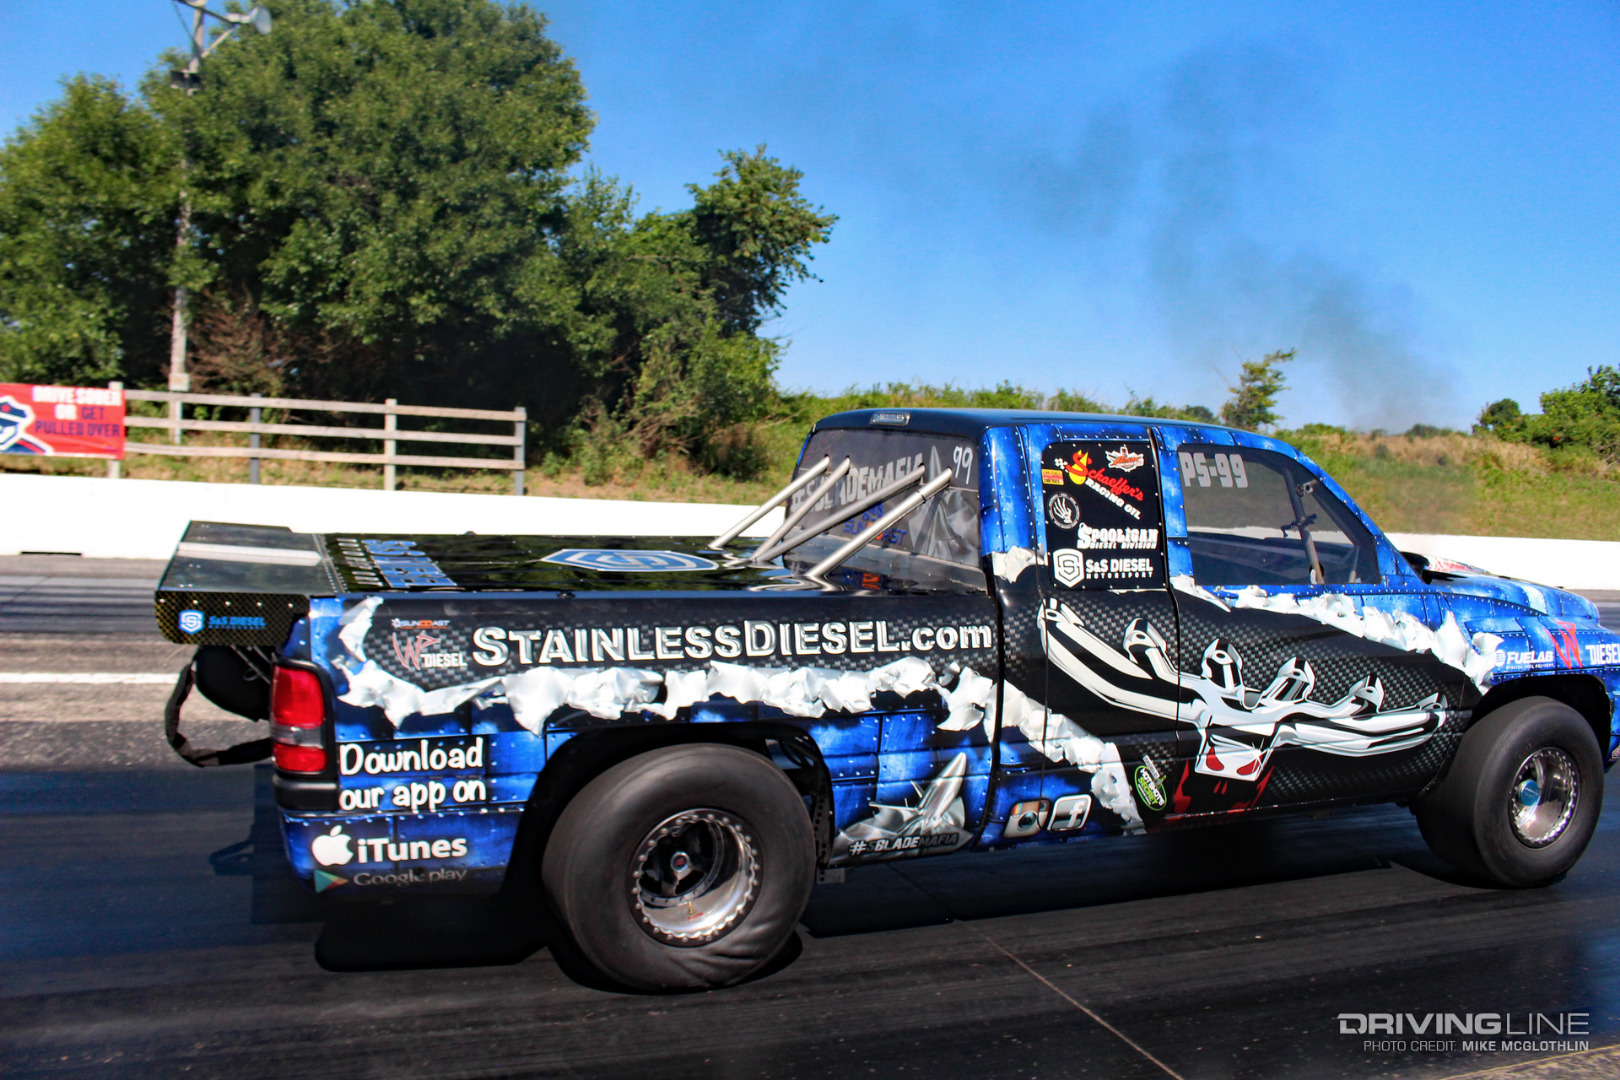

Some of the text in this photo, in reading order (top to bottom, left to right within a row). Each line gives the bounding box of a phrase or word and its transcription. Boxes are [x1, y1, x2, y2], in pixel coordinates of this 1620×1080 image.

[81, 406, 104, 420] GET
[35, 421, 119, 437] PULLED OVER
[952, 446, 973, 484] 99
[1179, 452, 1248, 488] PS-99
[1085, 477, 1141, 520] RACING OIL
[1085, 558, 1154, 573] S&S DIESEL
[420, 653, 468, 668] DIESEL
[339, 737, 483, 775] Download
[340, 780, 486, 813] our app on
[1137, 776, 1158, 805] SECRET
[357, 838, 468, 863] iTunes
[428, 868, 468, 883] play
